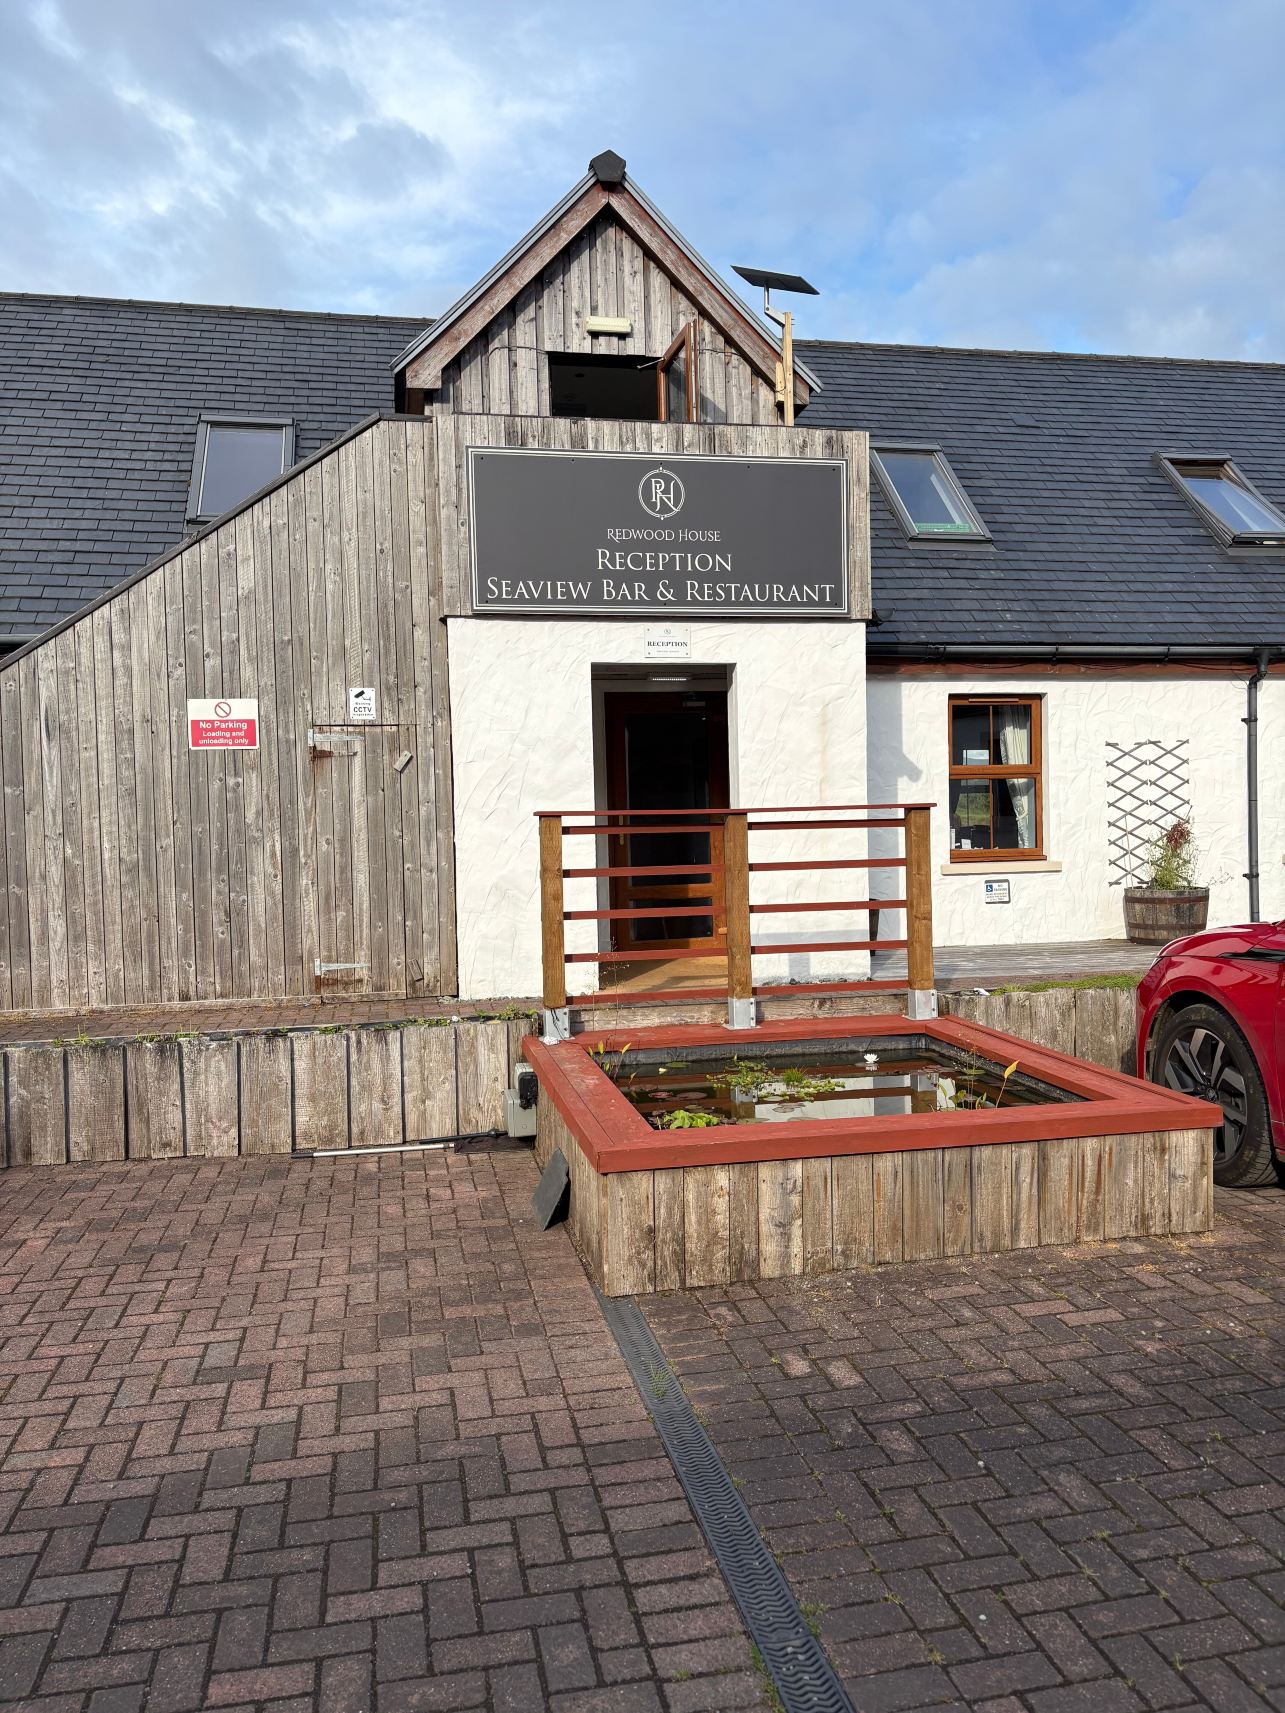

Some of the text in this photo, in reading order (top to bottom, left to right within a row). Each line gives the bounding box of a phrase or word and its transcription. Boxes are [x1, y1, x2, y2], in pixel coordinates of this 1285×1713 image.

[607, 528, 721, 543] REDWOOD HOUSE
[596, 548, 732, 572] RECEPTION
[487, 576, 835, 602] SEAVIEW BAR & RESTAURANT
[199, 721, 247, 730] No Parking
[202, 730, 230, 738] Loading
[234, 737, 249, 745] only
